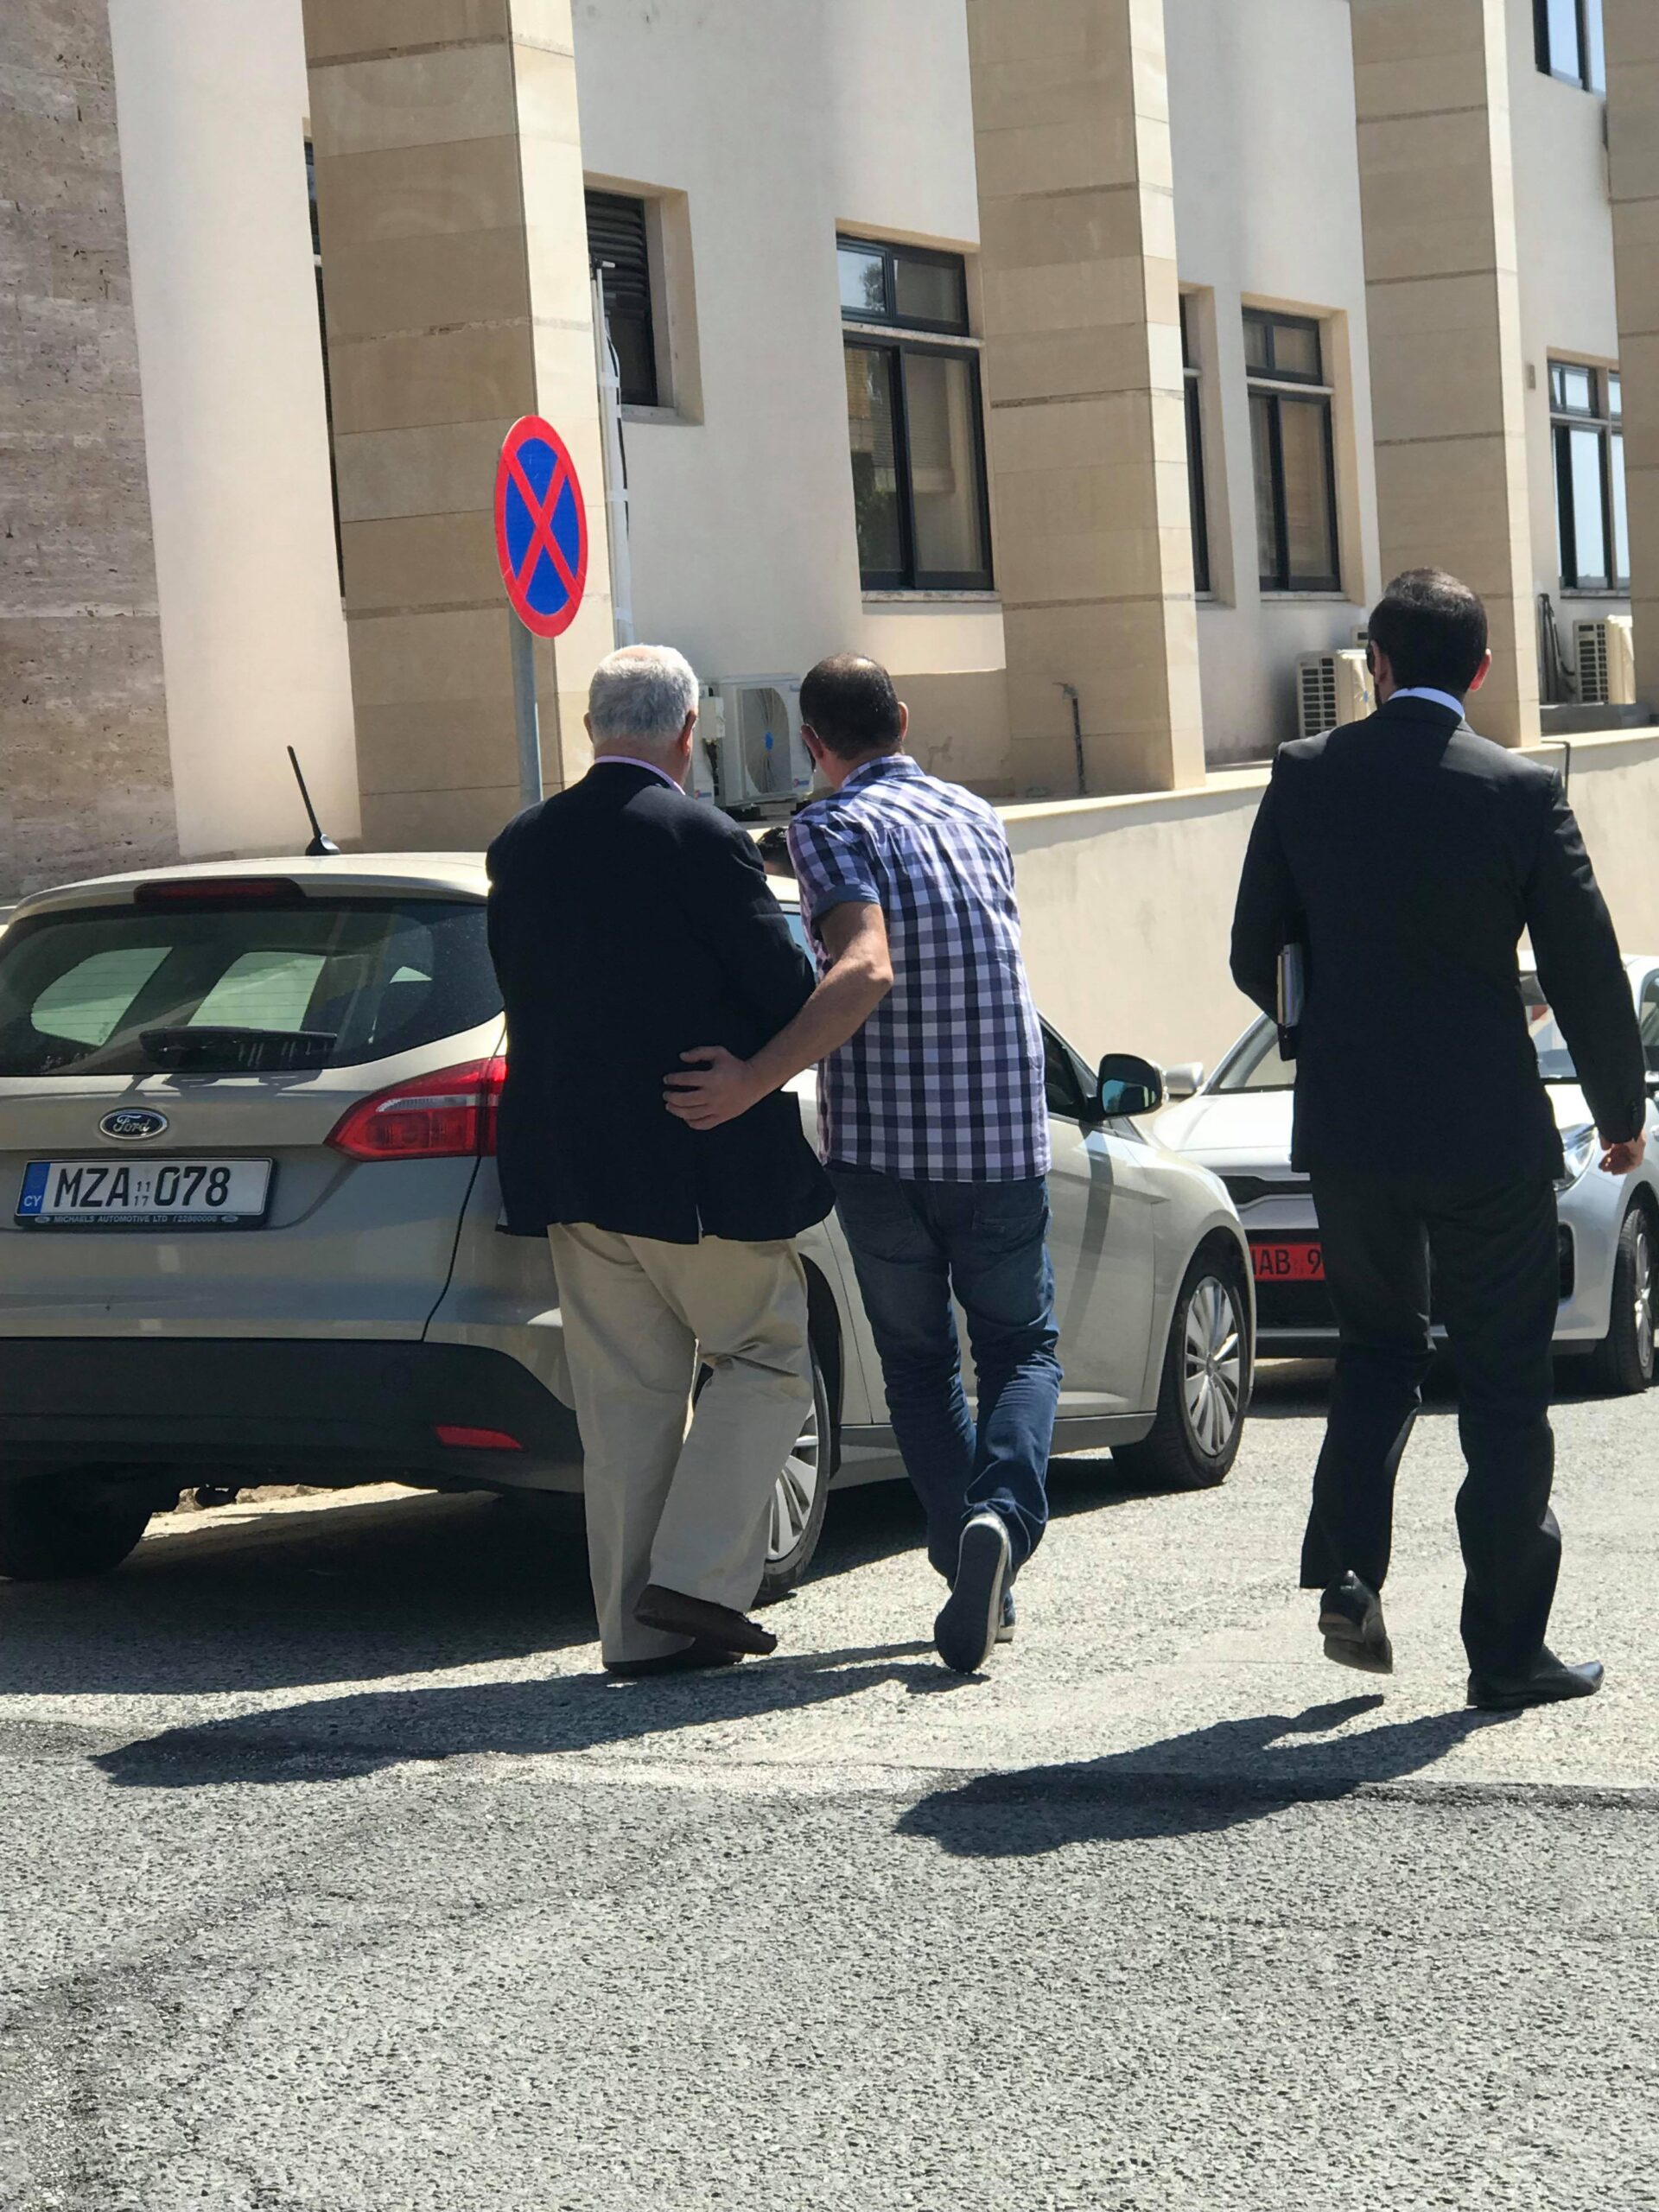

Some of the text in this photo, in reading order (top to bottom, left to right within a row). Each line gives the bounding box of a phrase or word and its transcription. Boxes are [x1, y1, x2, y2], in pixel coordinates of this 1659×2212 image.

[112, 1115, 151, 1132] Ford
[54, 1166, 231, 1207] MZA 078
[137, 1180, 150, 1192] 11
[23, 1195, 41, 1207] CY
[134, 1196, 149, 1206] 17
